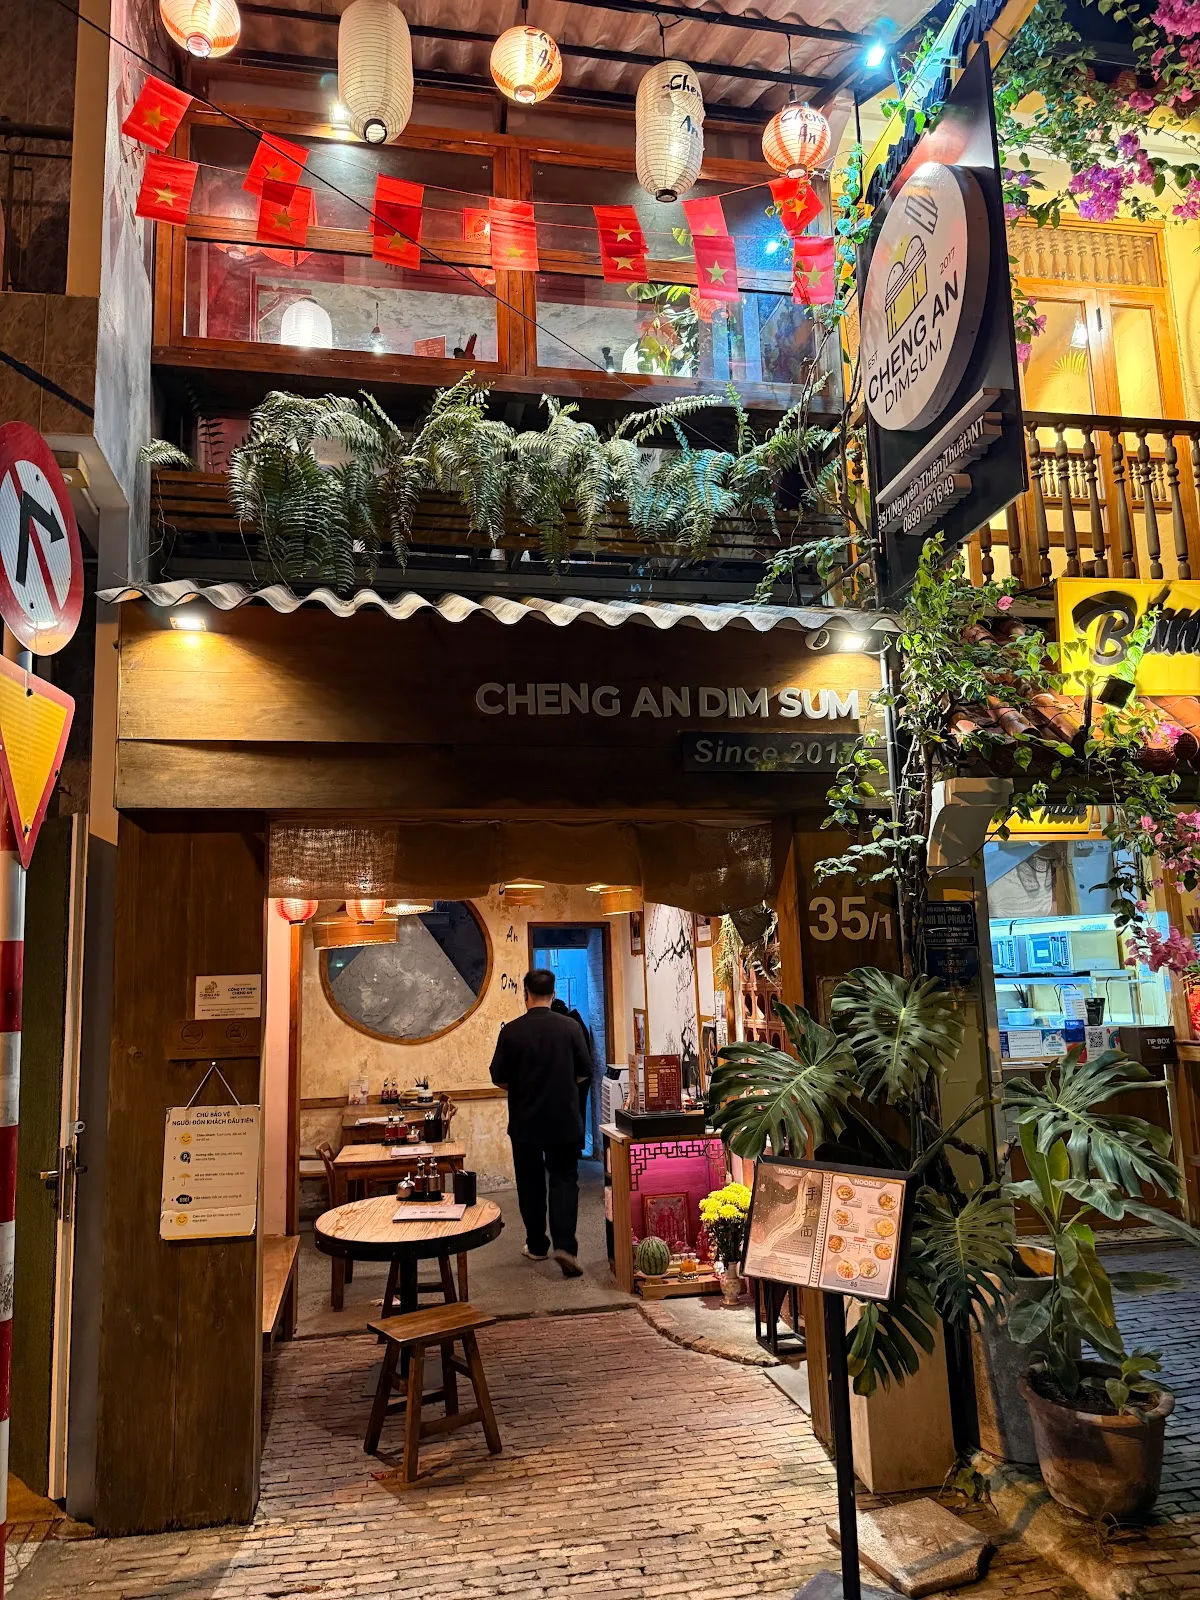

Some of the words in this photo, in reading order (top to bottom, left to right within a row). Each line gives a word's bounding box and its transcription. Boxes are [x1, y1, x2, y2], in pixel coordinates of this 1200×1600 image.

[797, 124, 817, 145] An
[940, 247, 956, 274] 2017
[868, 314, 927, 404] CHENG
[932, 270, 959, 328] AN
[868, 350, 878, 370] EST
[885, 328, 942, 415] DIMSUM
[920, 459, 943, 491] Thiện
[902, 507, 921, 533] 0899
[475, 682, 620, 718] CHENG
[631, 686, 690, 719] AN
[699, 687, 771, 718] DIM
[778, 687, 860, 720] SUM
[694, 739, 779, 765] Since
[790, 741, 859, 765] 2017
[808, 896, 893, 942] 35/1
[506, 925, 519, 943] An
[1157, 1037, 1171, 1045] BOX
[778, 1167, 803, 1176] NOODLE
[855, 1178, 880, 1188] NOODLE
